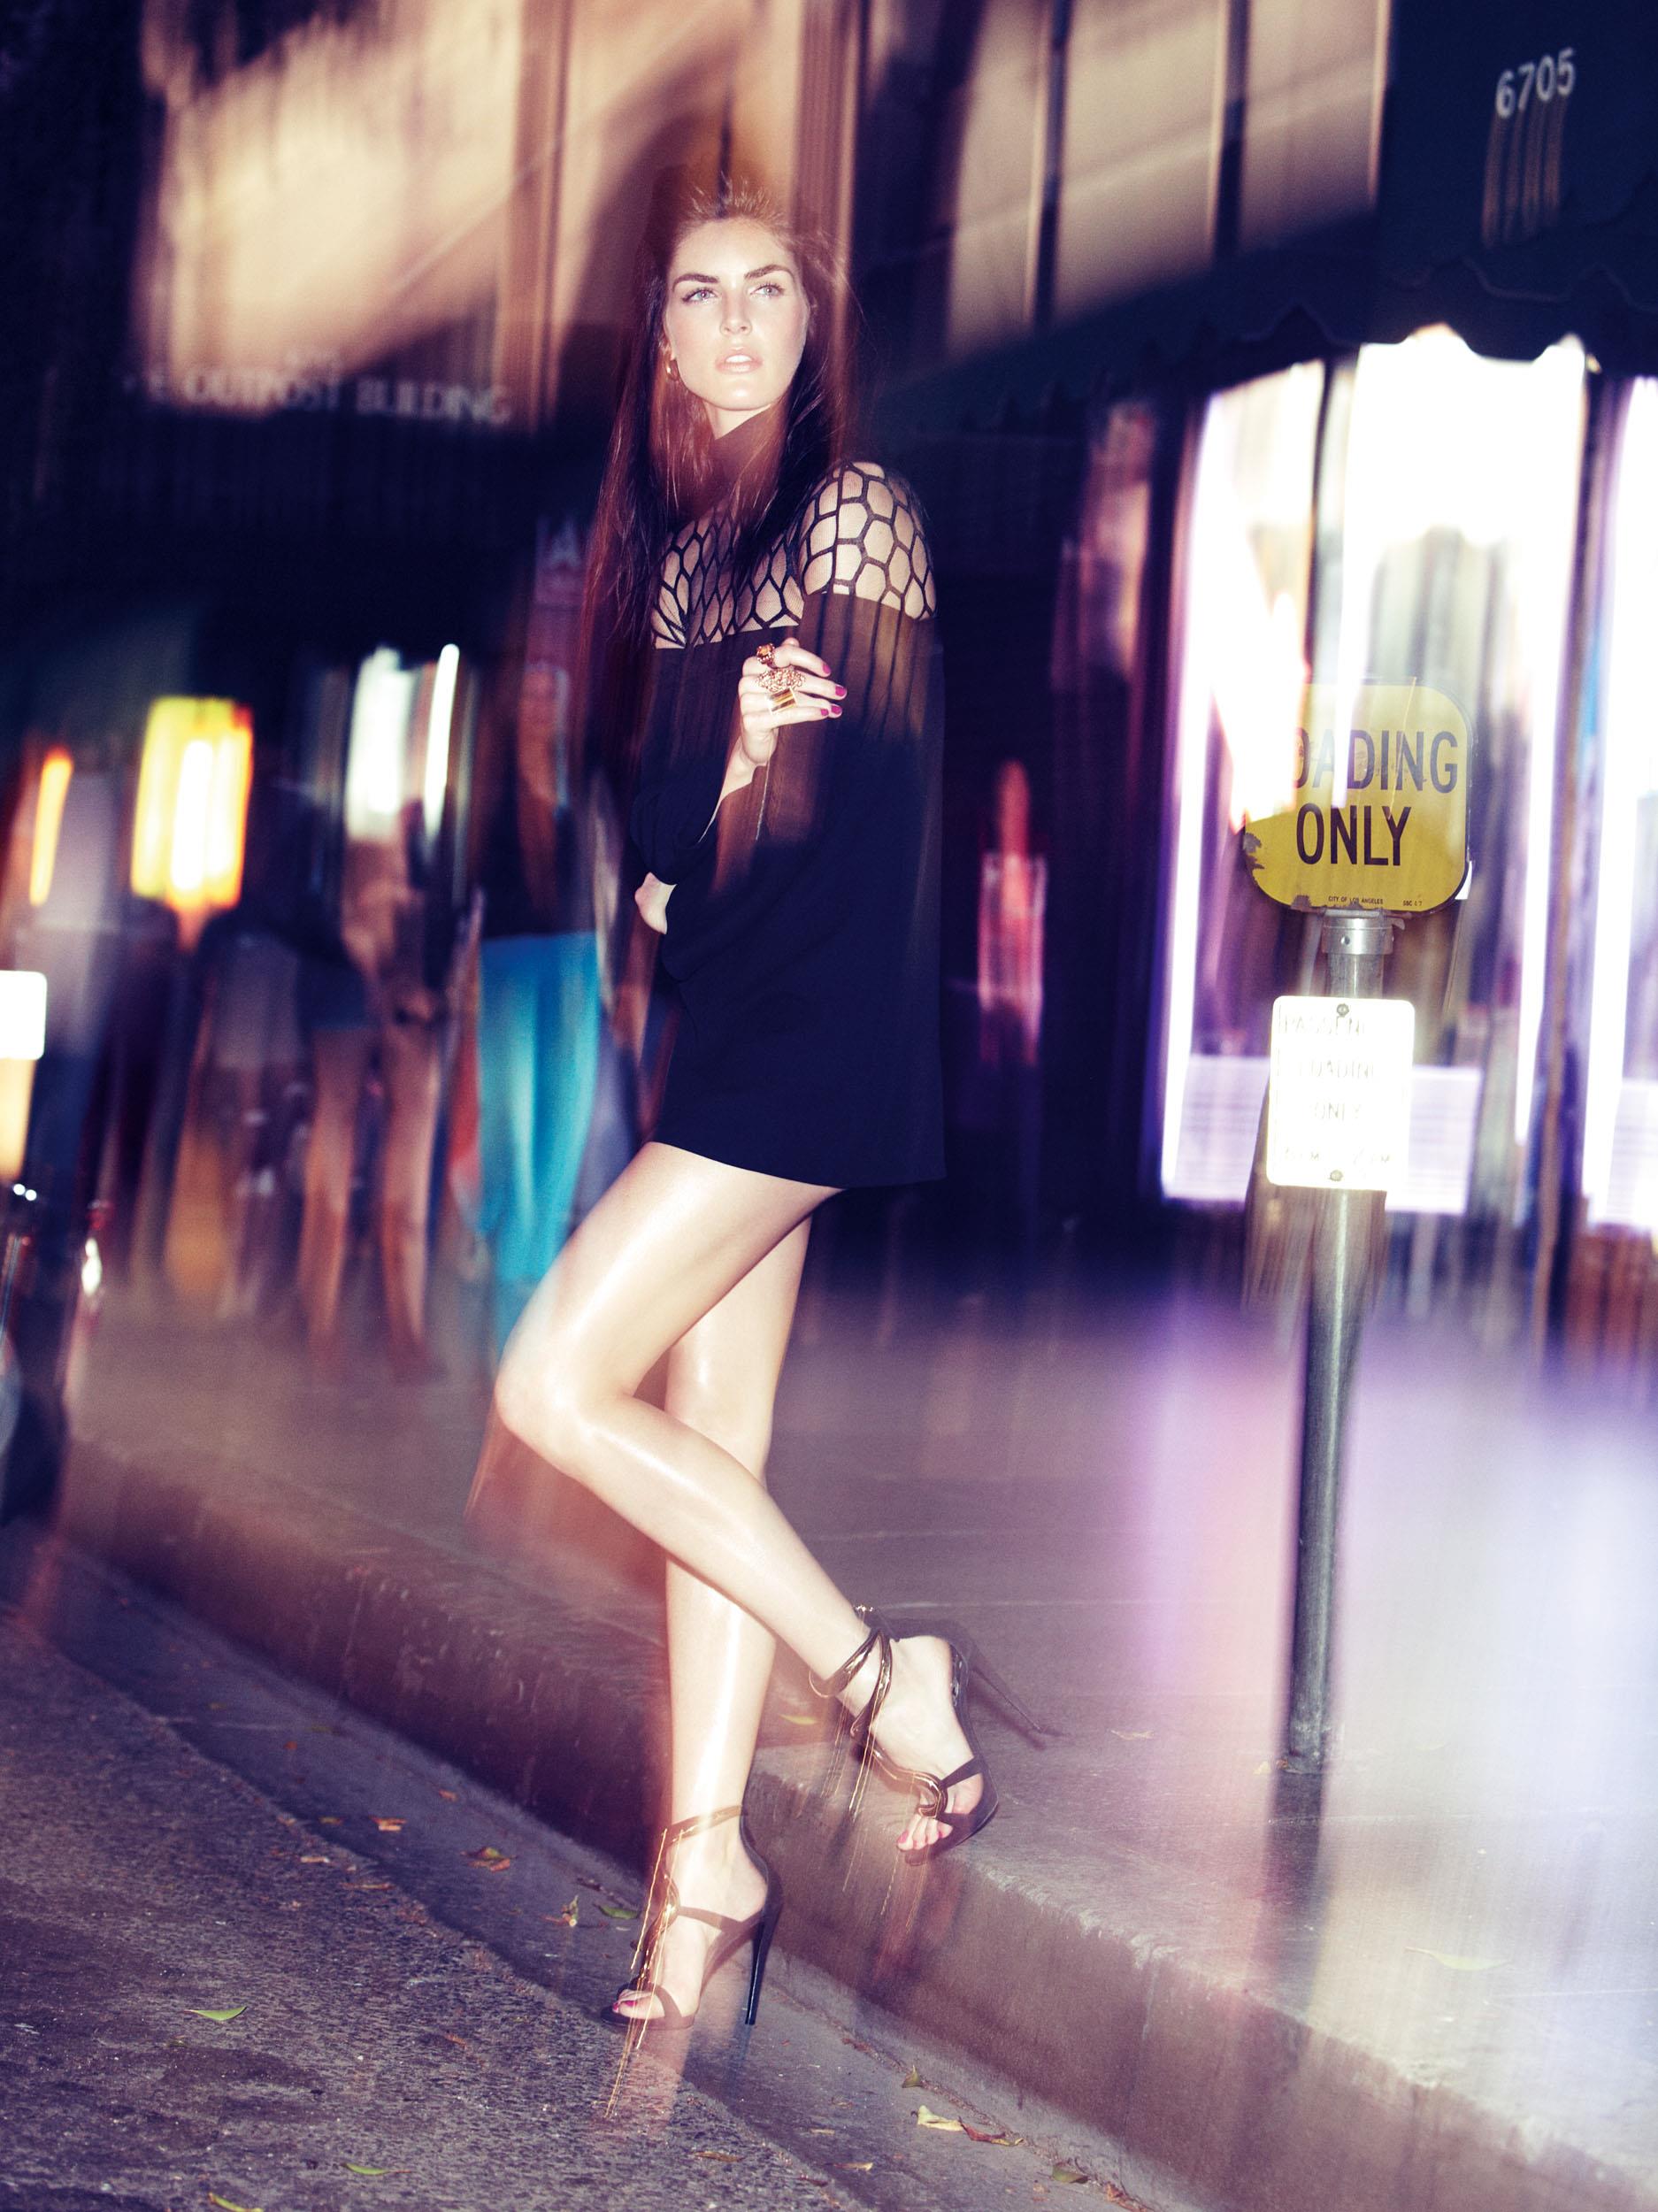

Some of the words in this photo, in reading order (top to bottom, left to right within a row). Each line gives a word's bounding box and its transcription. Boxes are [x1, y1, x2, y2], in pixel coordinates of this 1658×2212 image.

[1495, 47, 1576, 119] 6705
[1293, 727, 1458, 795] OADING
[1295, 803, 1412, 866] ONLY
